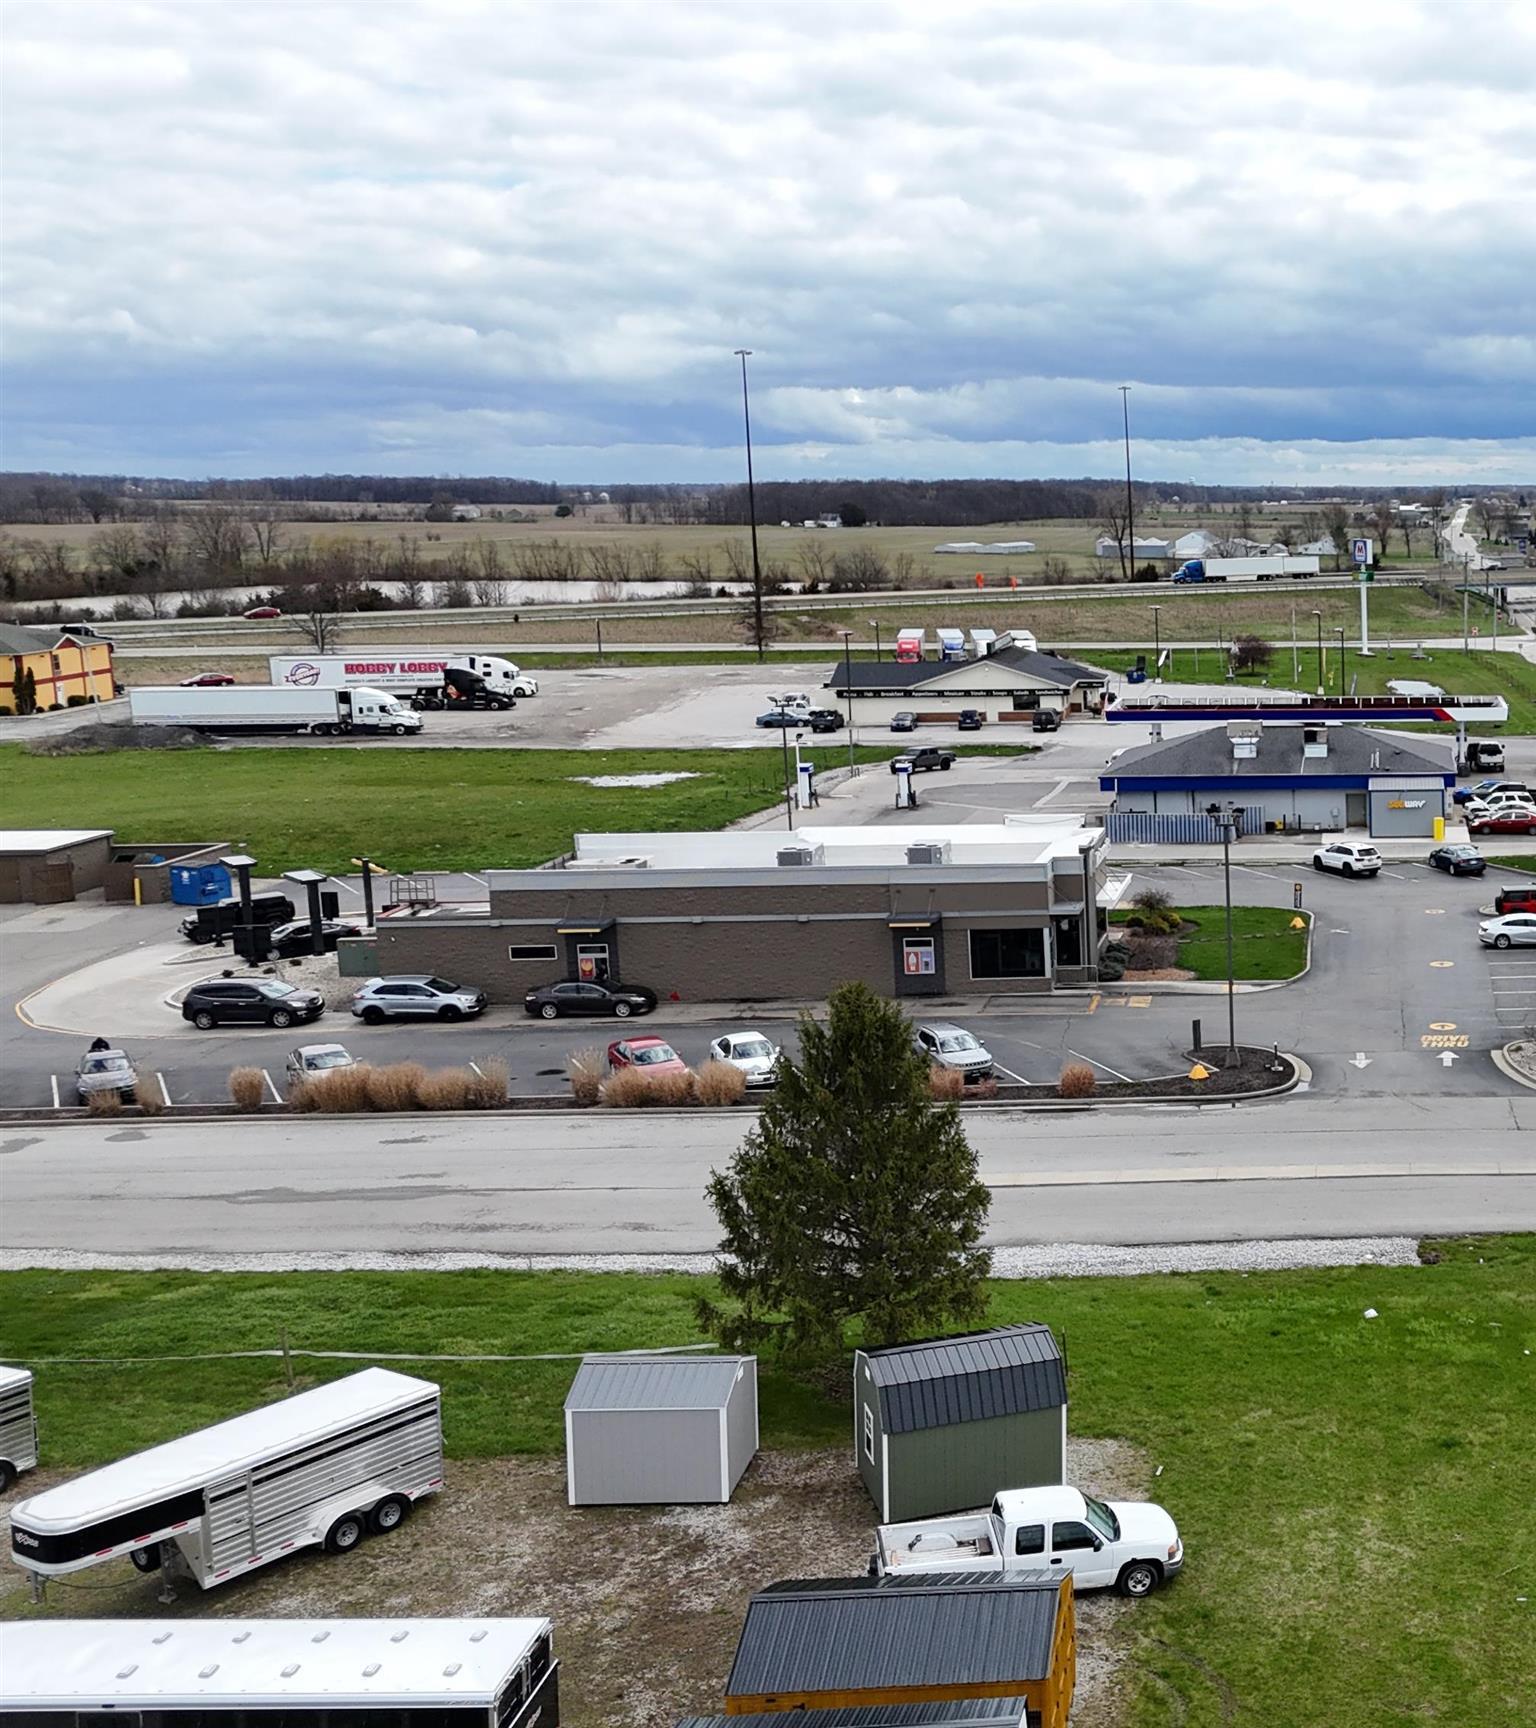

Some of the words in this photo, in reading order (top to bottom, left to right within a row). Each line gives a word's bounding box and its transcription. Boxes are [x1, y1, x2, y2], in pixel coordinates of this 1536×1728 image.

[344, 662, 396, 675] HOBBY
[399, 661, 448, 675] LOBBY
[880, 690, 904, 698] Breakfast
[1420, 1034, 1470, 1042] DRIVE
